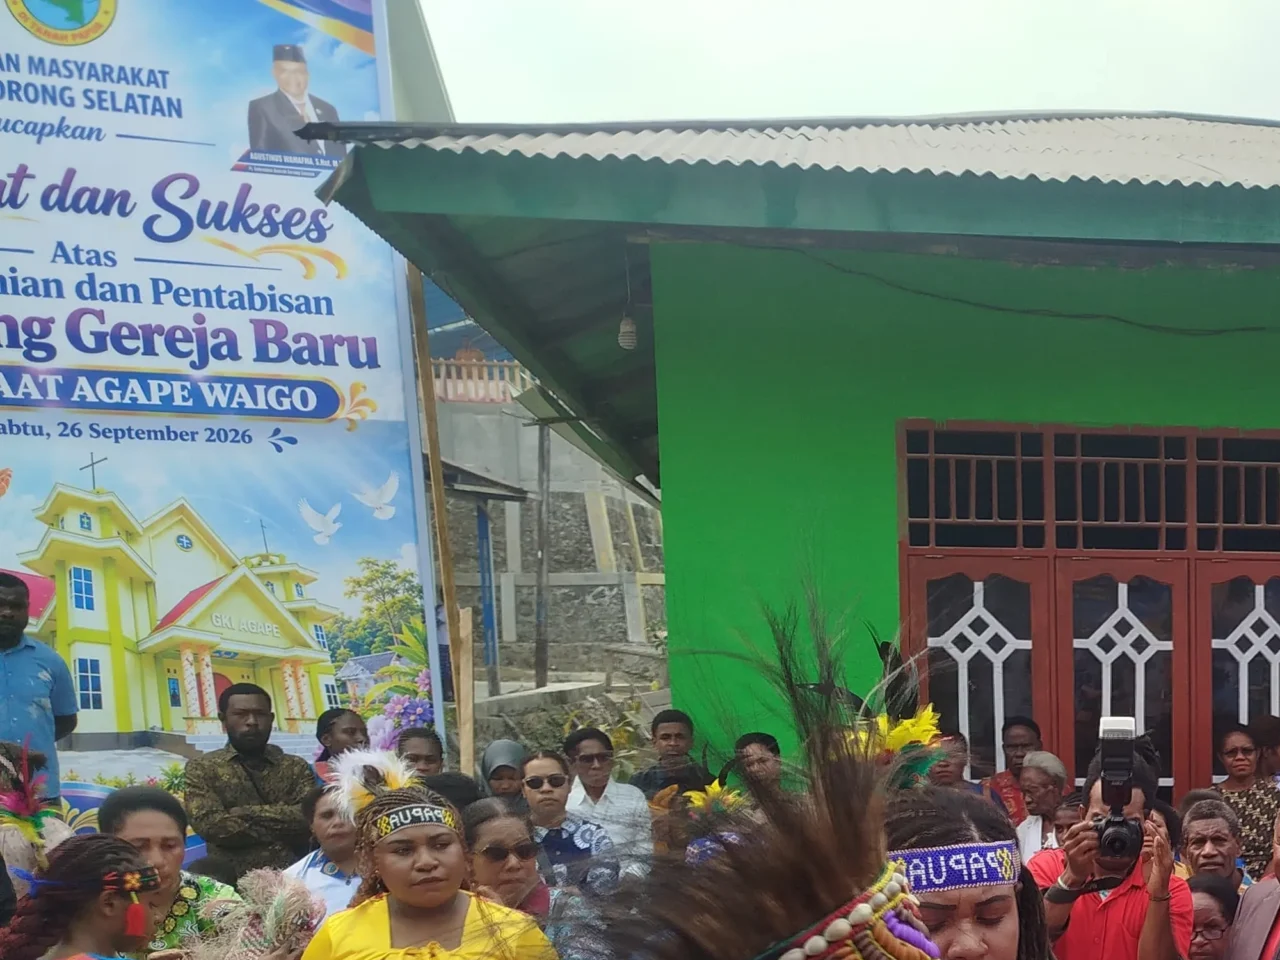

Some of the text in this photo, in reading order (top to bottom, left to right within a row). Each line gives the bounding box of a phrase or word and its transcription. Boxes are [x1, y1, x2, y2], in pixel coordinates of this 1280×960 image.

[28, 55, 170, 89] MASYARAKAT
[82, 88, 183, 118] SELATAN
[40, 167, 137, 218] dan
[142, 172, 334, 243] Sukses
[51, 240, 118, 267] Atas
[75, 272, 142, 303] dan
[150, 277, 335, 316] Pentabisan
[65, 307, 241, 371] Gereja
[249, 318, 381, 370] Baru
[71, 376, 193, 408] AGAPE
[197, 382, 317, 412] WAIGO
[57, 421, 83, 438] 26
[89, 423, 199, 444] September
[204, 427, 253, 445] 2026
[211, 612, 281, 638] GKI AGAPE
